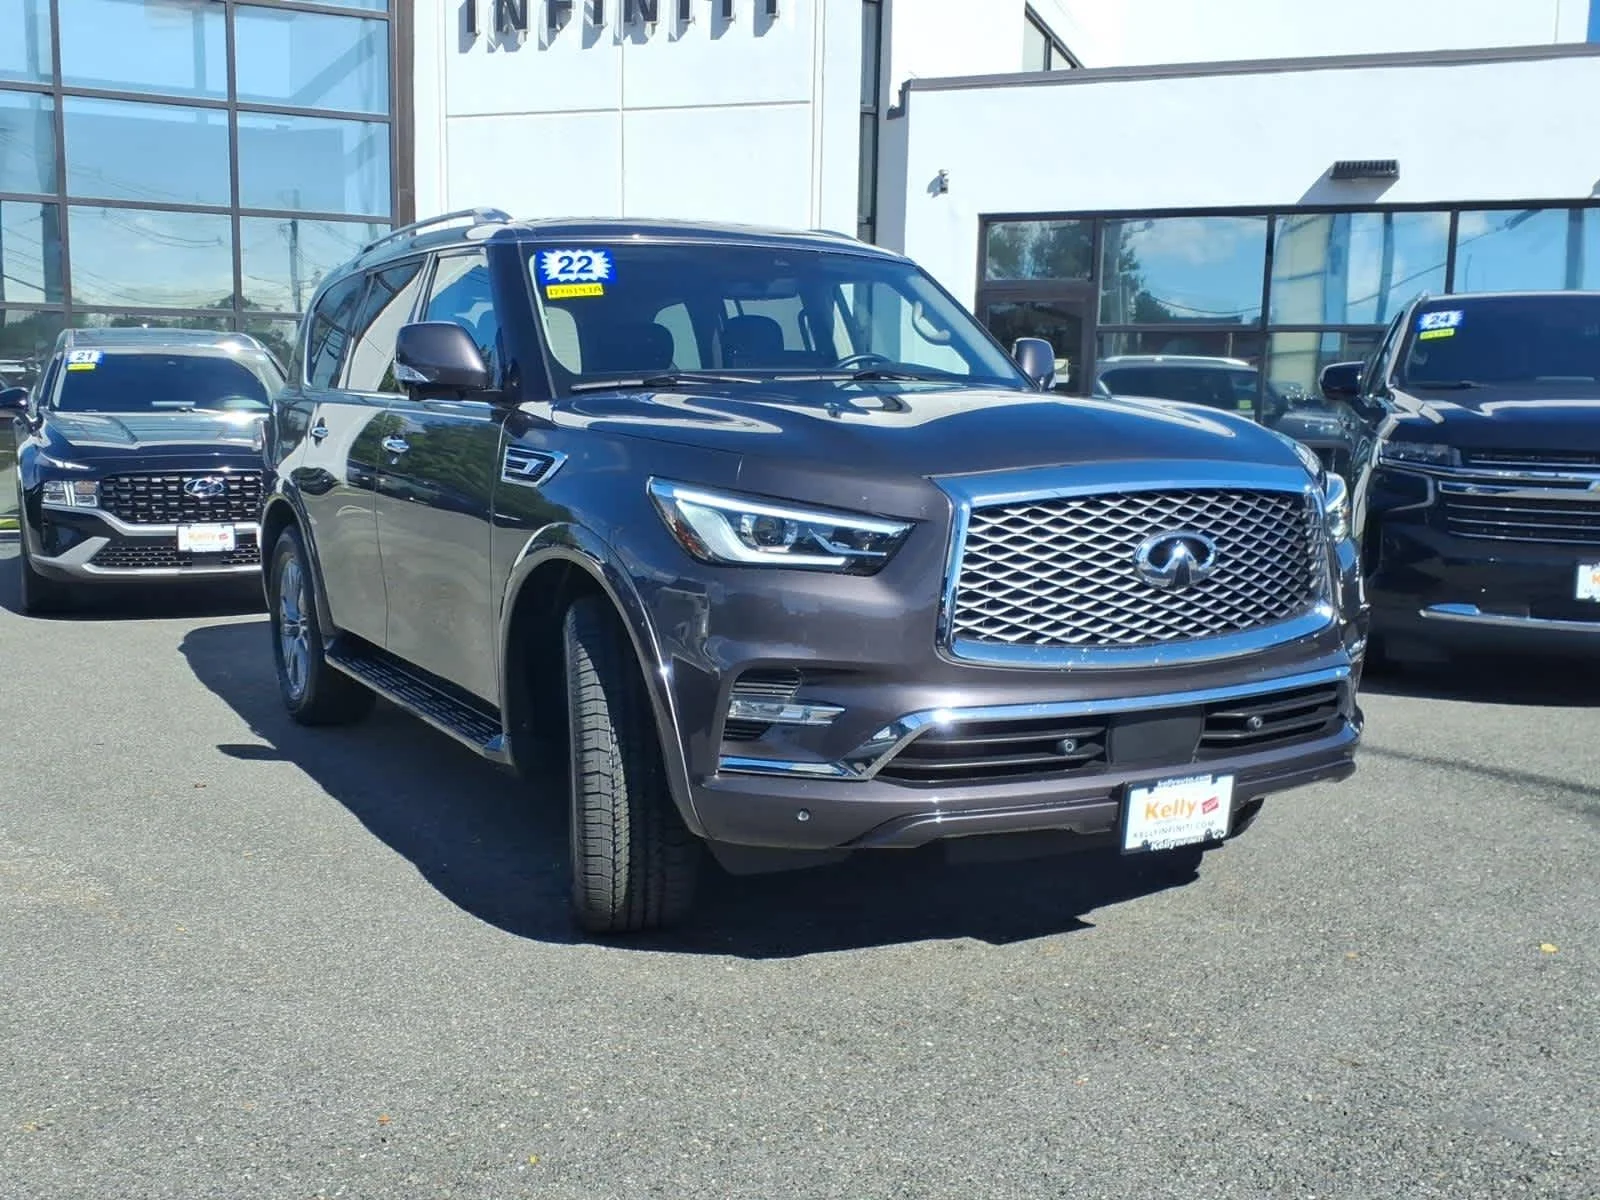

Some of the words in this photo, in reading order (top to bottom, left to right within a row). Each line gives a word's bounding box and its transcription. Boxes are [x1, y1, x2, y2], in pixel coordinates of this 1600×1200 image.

[466, 0, 777, 32] INFI
[558, 255, 593, 275] 22
[76, 352, 94, 361] 21
[1144, 798, 1197, 820] Kelly
